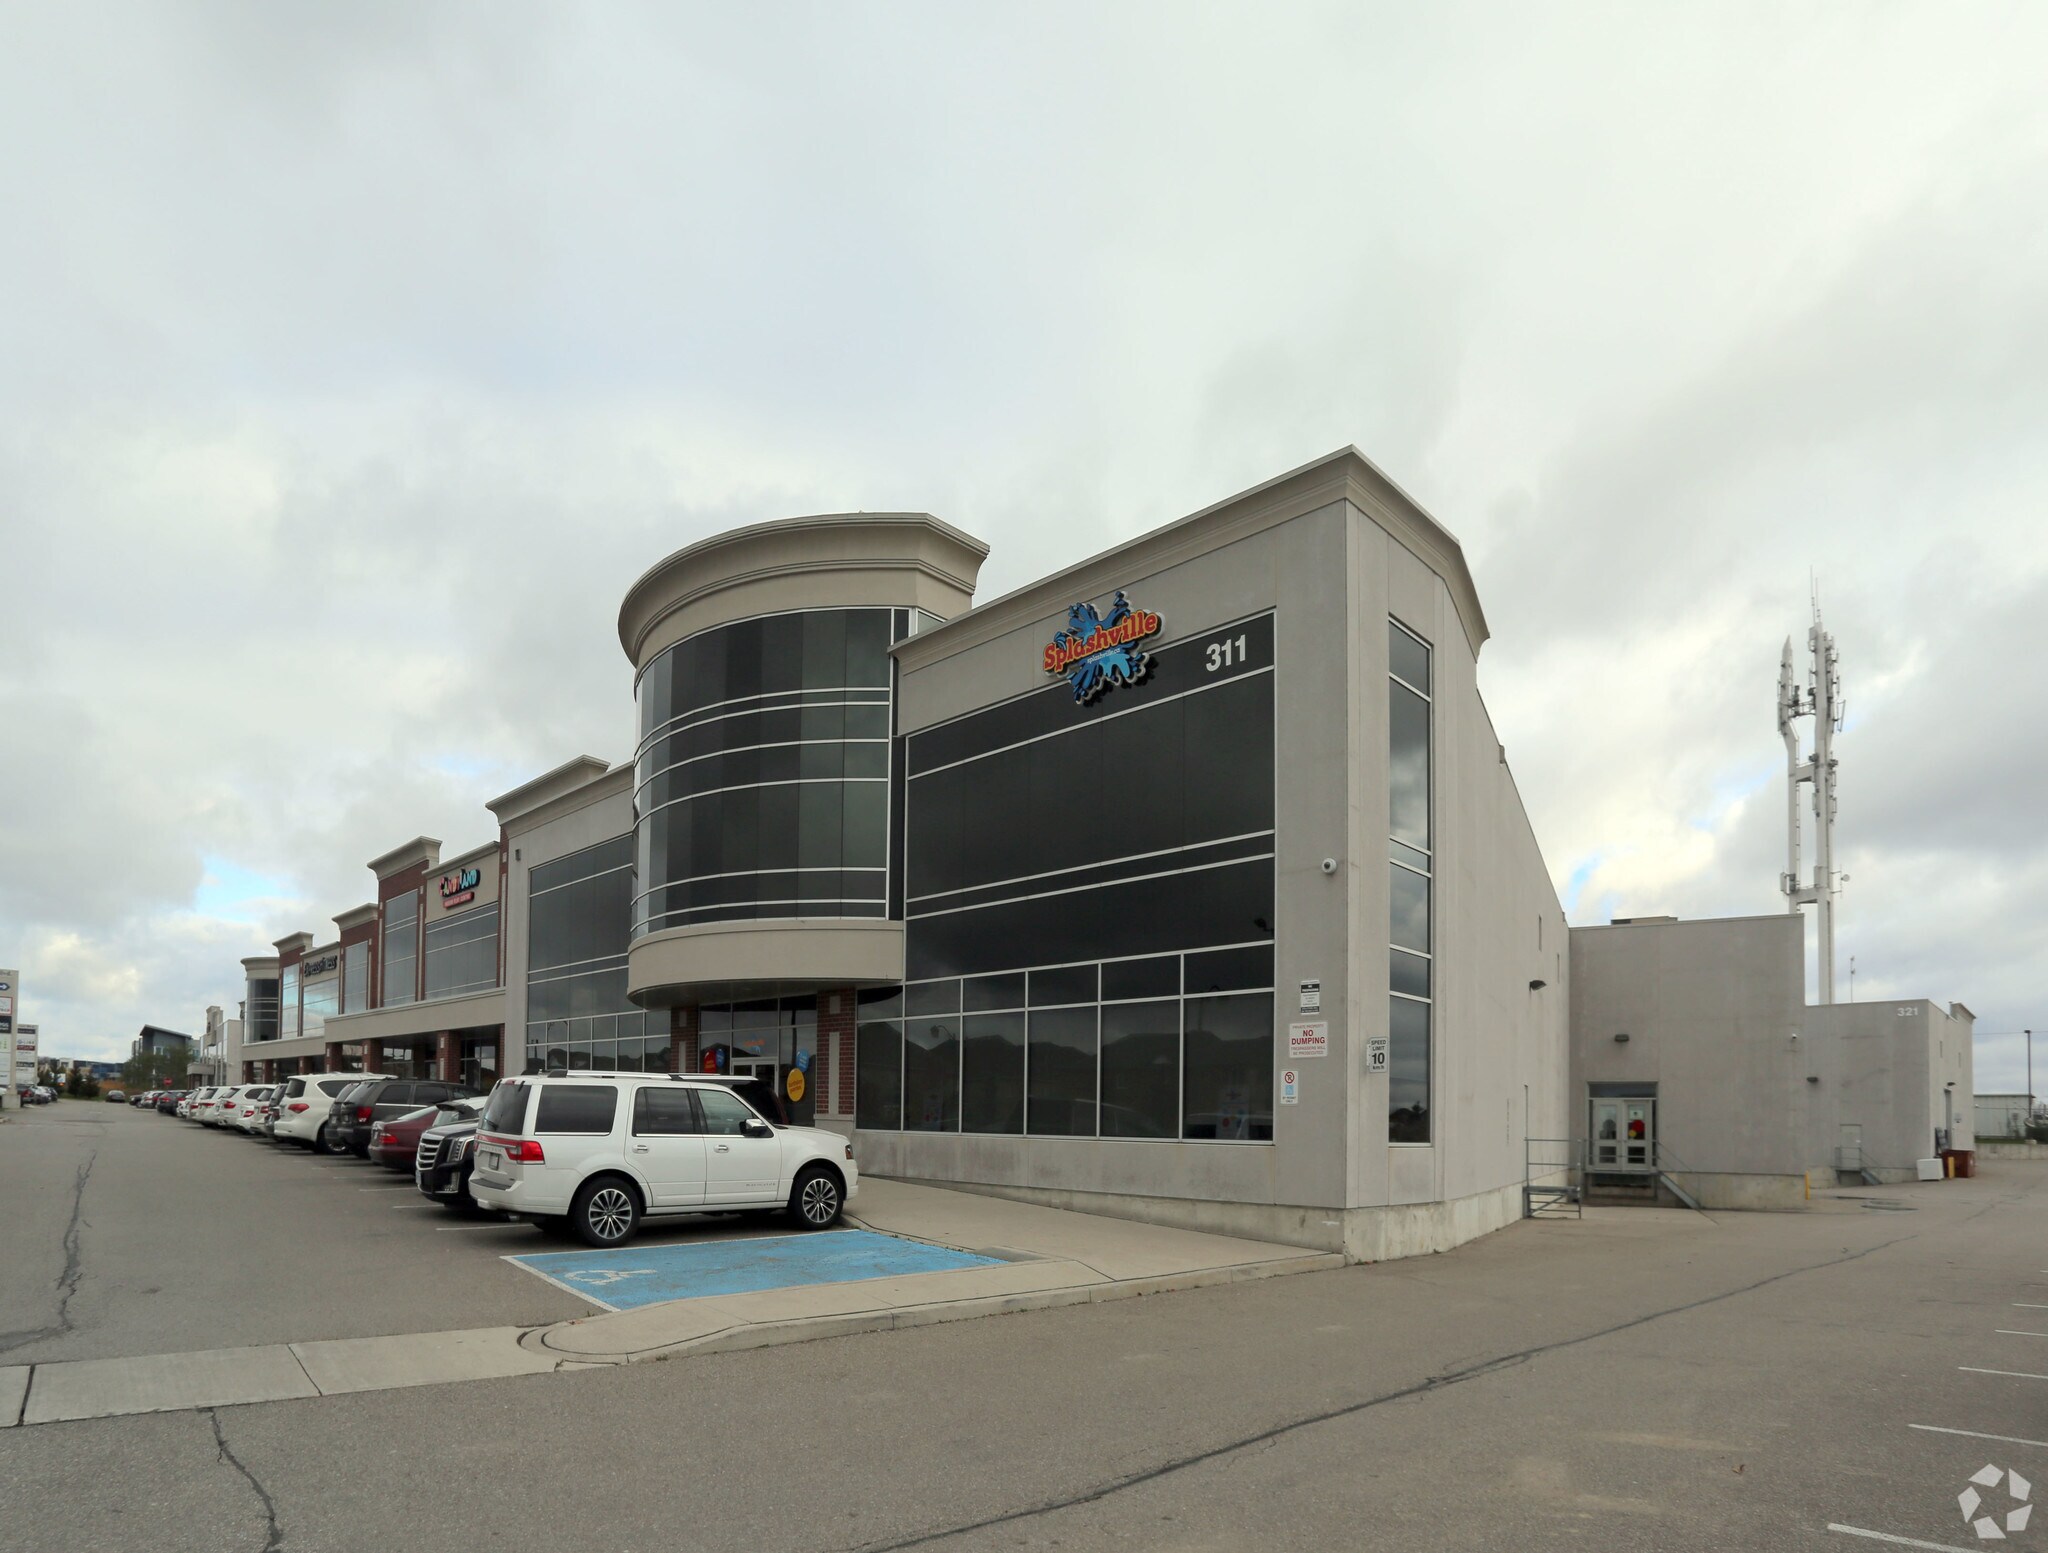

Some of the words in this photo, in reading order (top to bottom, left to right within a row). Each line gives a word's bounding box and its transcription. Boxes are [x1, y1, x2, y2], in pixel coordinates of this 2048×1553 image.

[1044, 609, 1158, 673] Splashville
[1205, 634, 1246, 672] 311
[1897, 1007, 1918, 1017] 321
[1302, 1029, 1314, 1037] NO
[1291, 1036, 1326, 1045] DUMPING
[1371, 1052, 1385, 1065] 10
